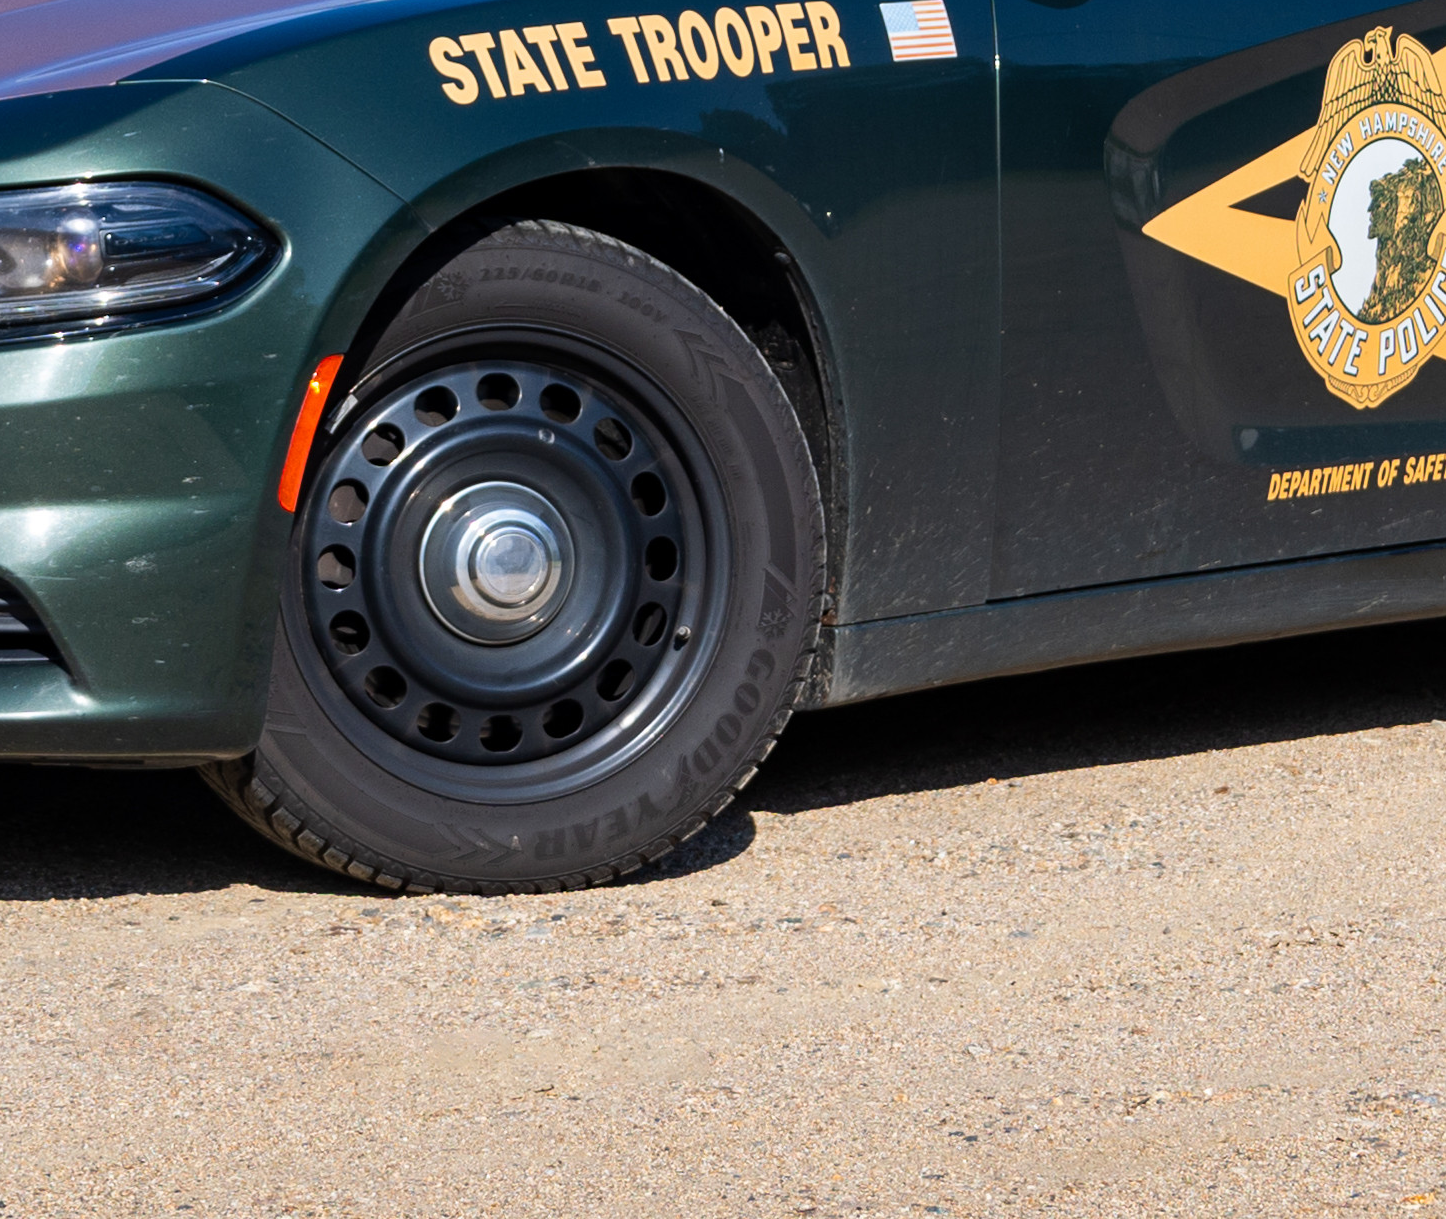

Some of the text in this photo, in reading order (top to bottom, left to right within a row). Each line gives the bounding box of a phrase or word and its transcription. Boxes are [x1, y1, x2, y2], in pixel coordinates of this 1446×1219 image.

[428, 0, 851, 105] STATE TROOPER
[1321, 136, 1355, 185] NEW
[1295, 264, 1369, 376] STATE
[1267, 459, 1374, 501] DEPARTMENT
[1376, 458, 1400, 488] OF
[534, 648, 775, 858] GOODYEAR
